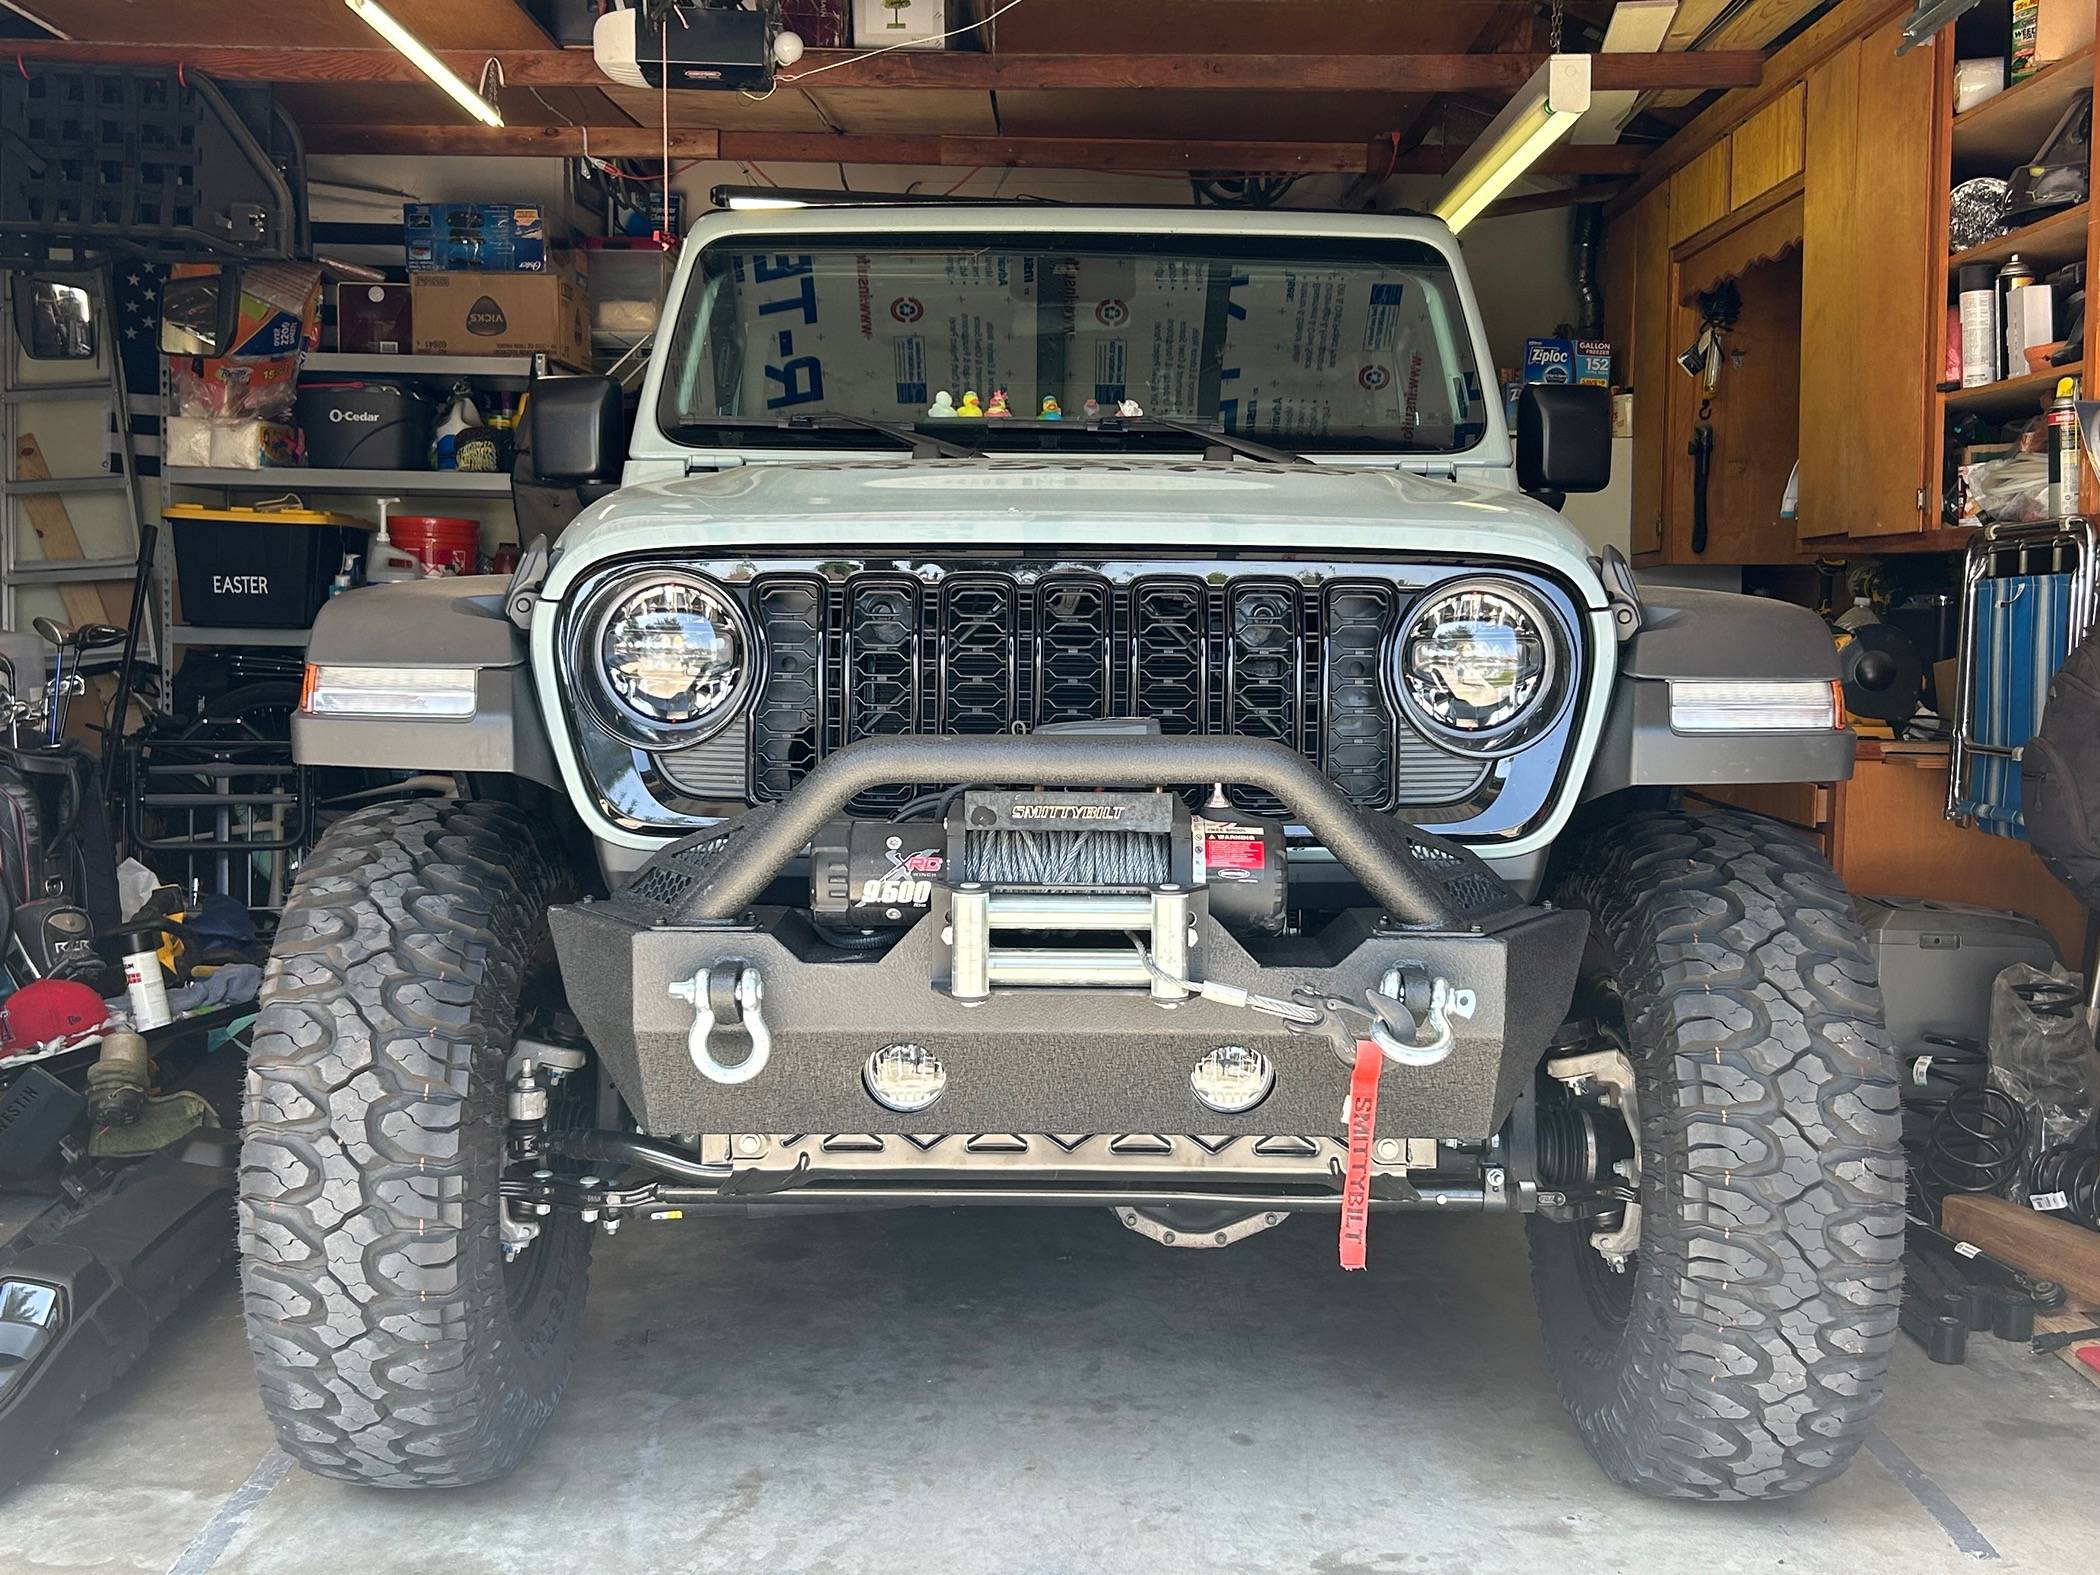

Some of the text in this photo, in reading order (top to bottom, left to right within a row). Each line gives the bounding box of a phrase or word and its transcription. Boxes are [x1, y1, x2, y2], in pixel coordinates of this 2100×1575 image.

[470, 313, 503, 323] VICKS
[1580, 342, 1610, 350] GALLON
[1532, 349, 1568, 365] Ziploc
[1586, 358, 1609, 371] 152
[329, 409, 380, 423] O-Cedar
[213, 575, 269, 594] EASTER
[1011, 805, 1125, 820] SMITTYBILT
[1344, 1097, 1372, 1245] SMITTYBILT
